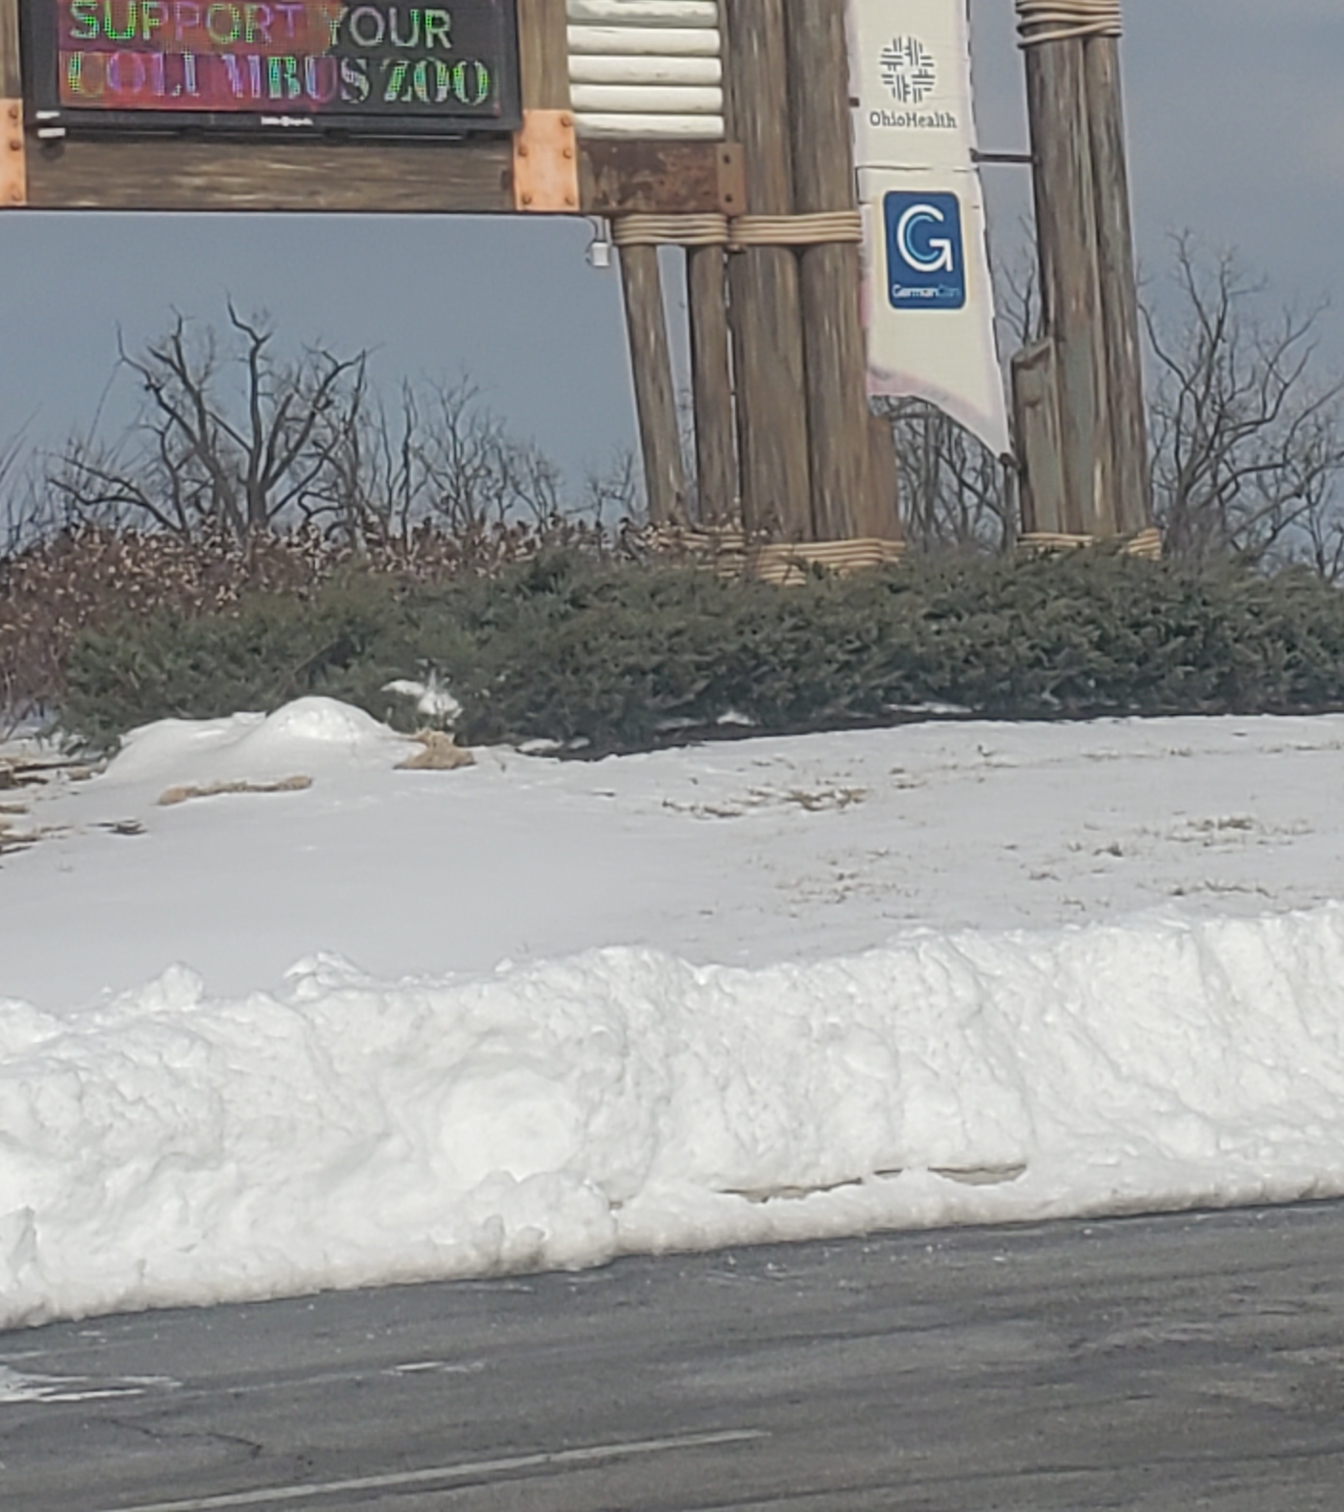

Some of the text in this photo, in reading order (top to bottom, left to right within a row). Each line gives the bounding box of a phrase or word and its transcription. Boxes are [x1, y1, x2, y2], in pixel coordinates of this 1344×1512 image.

[319, 5, 453, 49] YOUR
[379, 55, 490, 106] ZOO
[868, 110, 958, 129] OhioHealth
